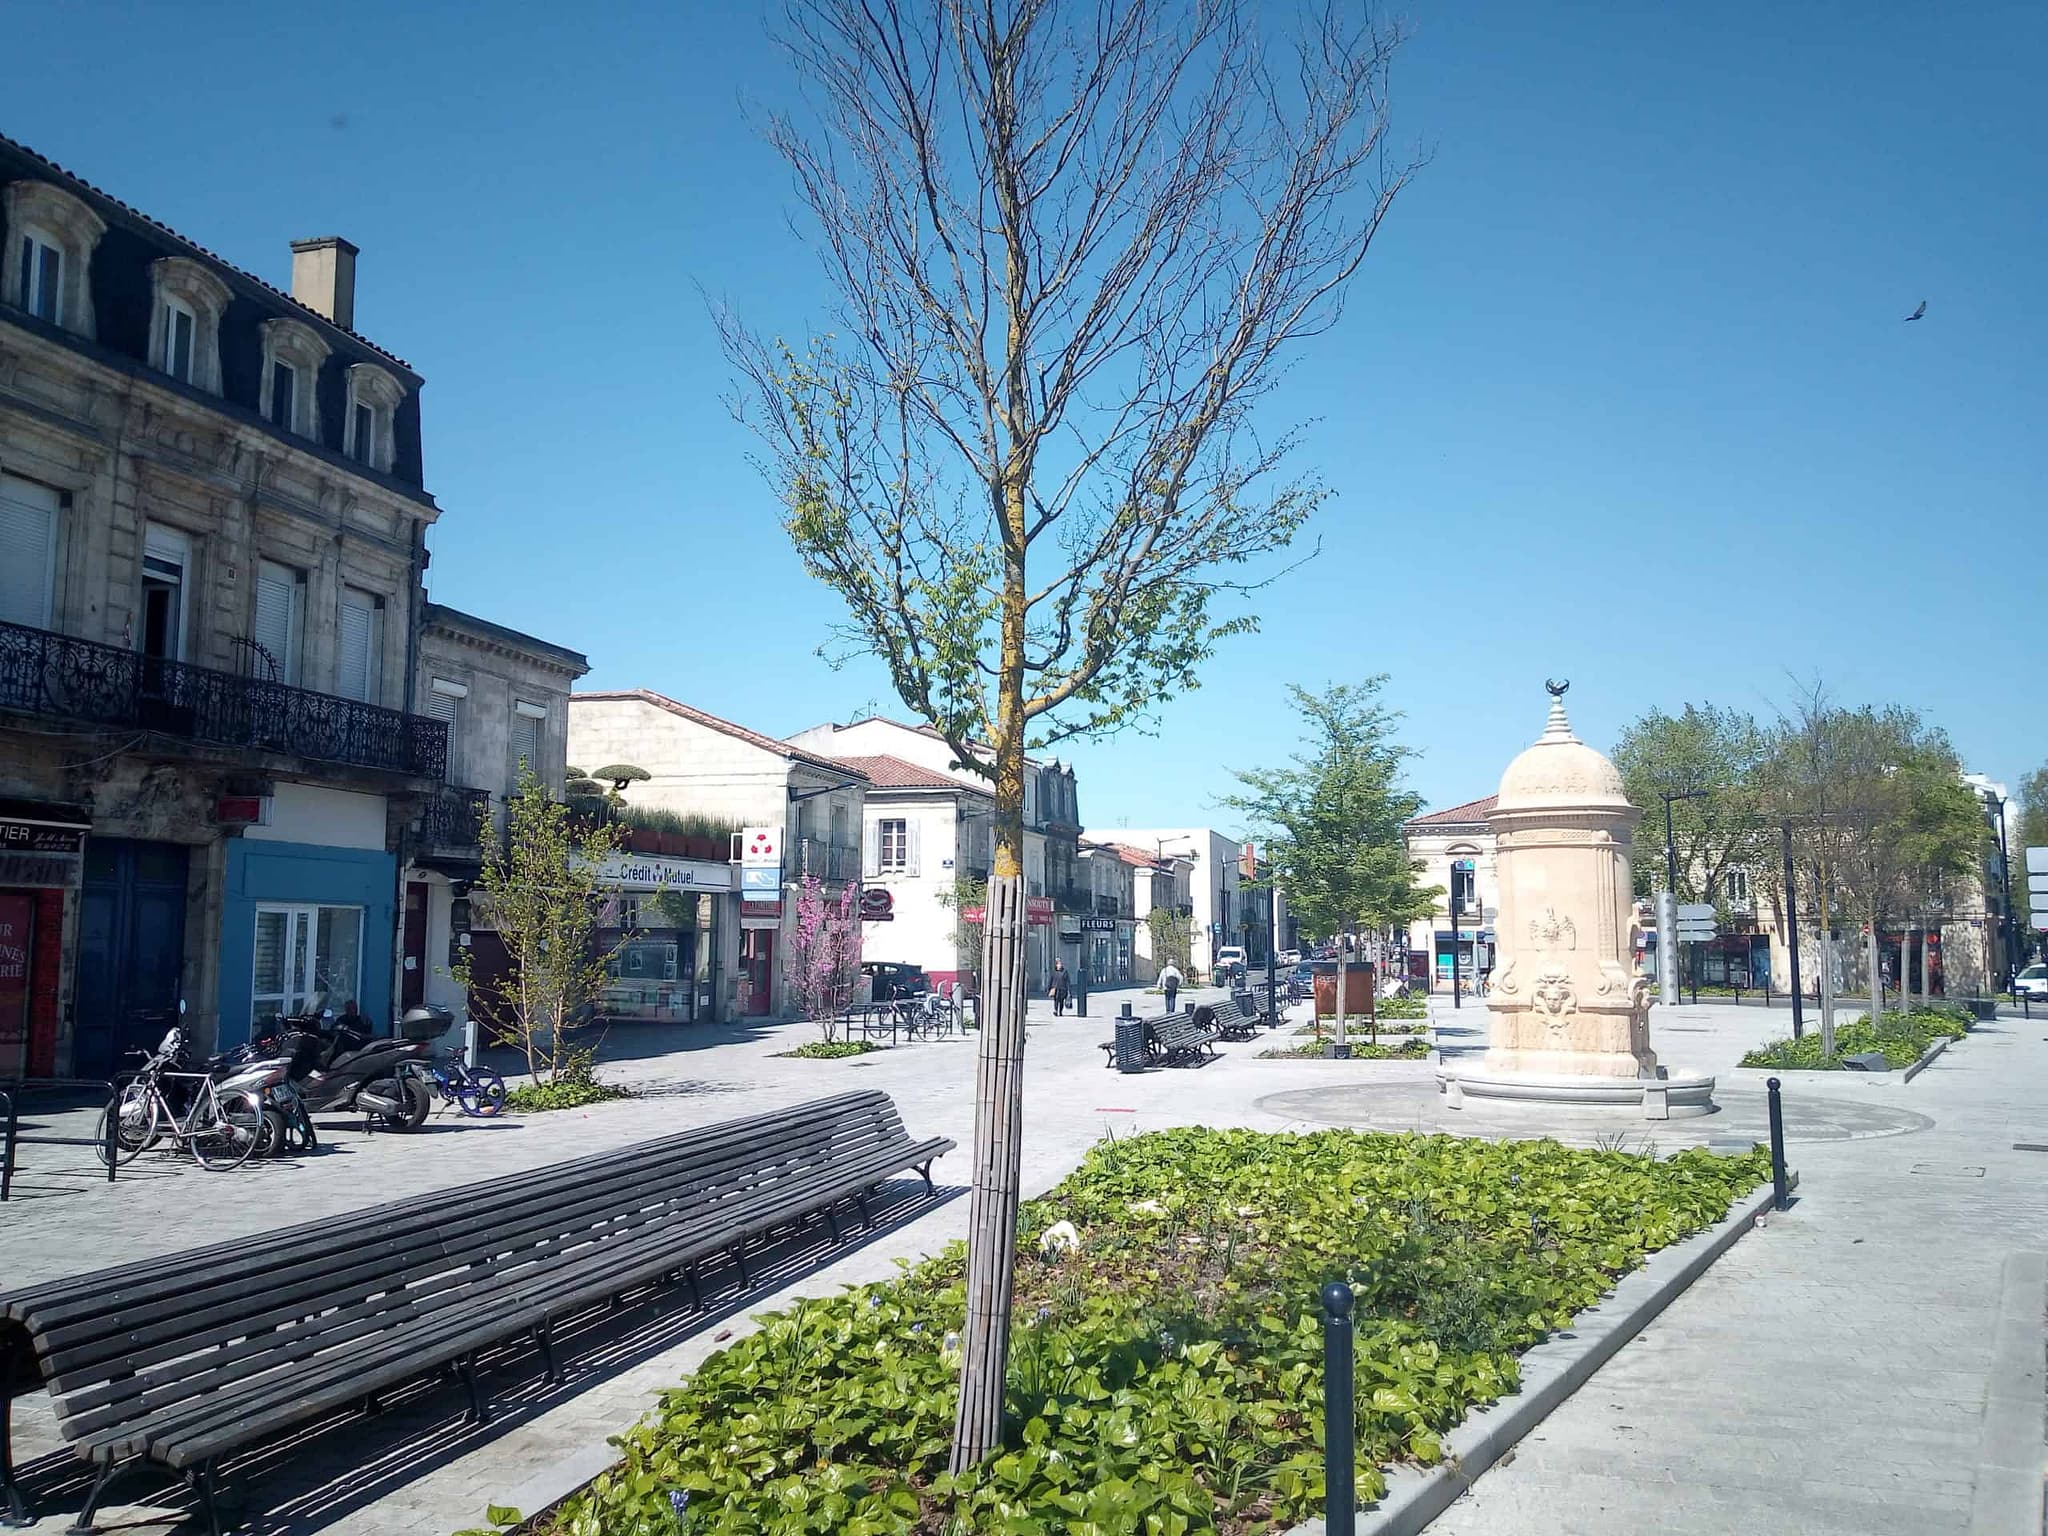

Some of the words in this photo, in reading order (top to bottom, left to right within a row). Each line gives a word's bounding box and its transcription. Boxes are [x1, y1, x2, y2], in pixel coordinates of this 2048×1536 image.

[621, 863, 651, 882] Crédit
[664, 867, 694, 885] Mutuel
[1082, 920, 1114, 928] FLEURS
